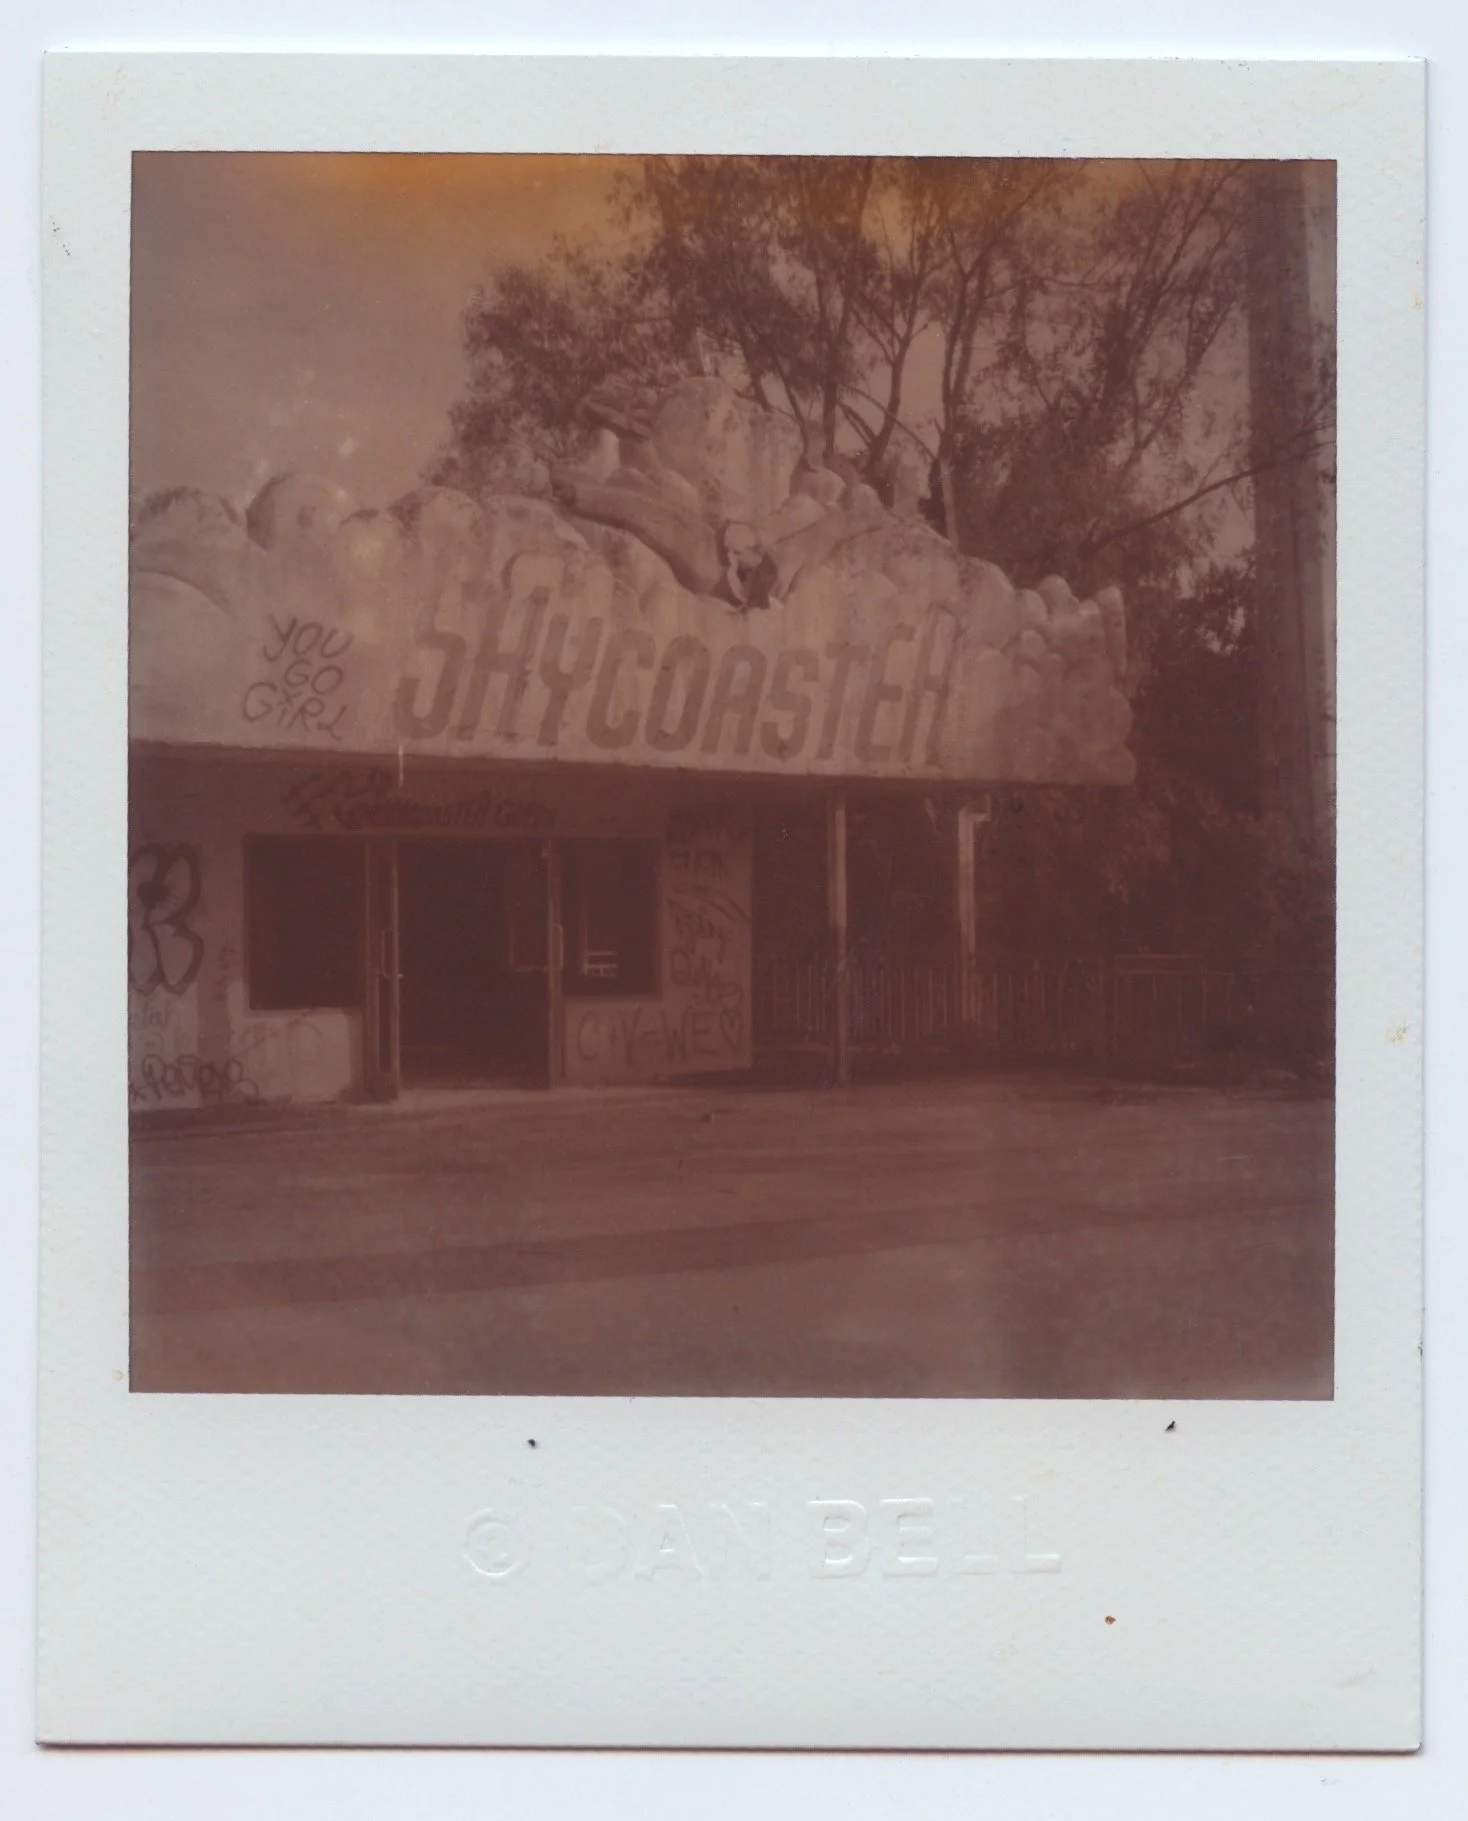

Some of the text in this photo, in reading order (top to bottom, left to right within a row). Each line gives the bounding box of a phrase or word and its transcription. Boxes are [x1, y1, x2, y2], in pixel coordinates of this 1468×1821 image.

[263, 612, 356, 663] YOU
[284, 658, 344, 695] GO
[242, 681, 348, 743] GIRL
